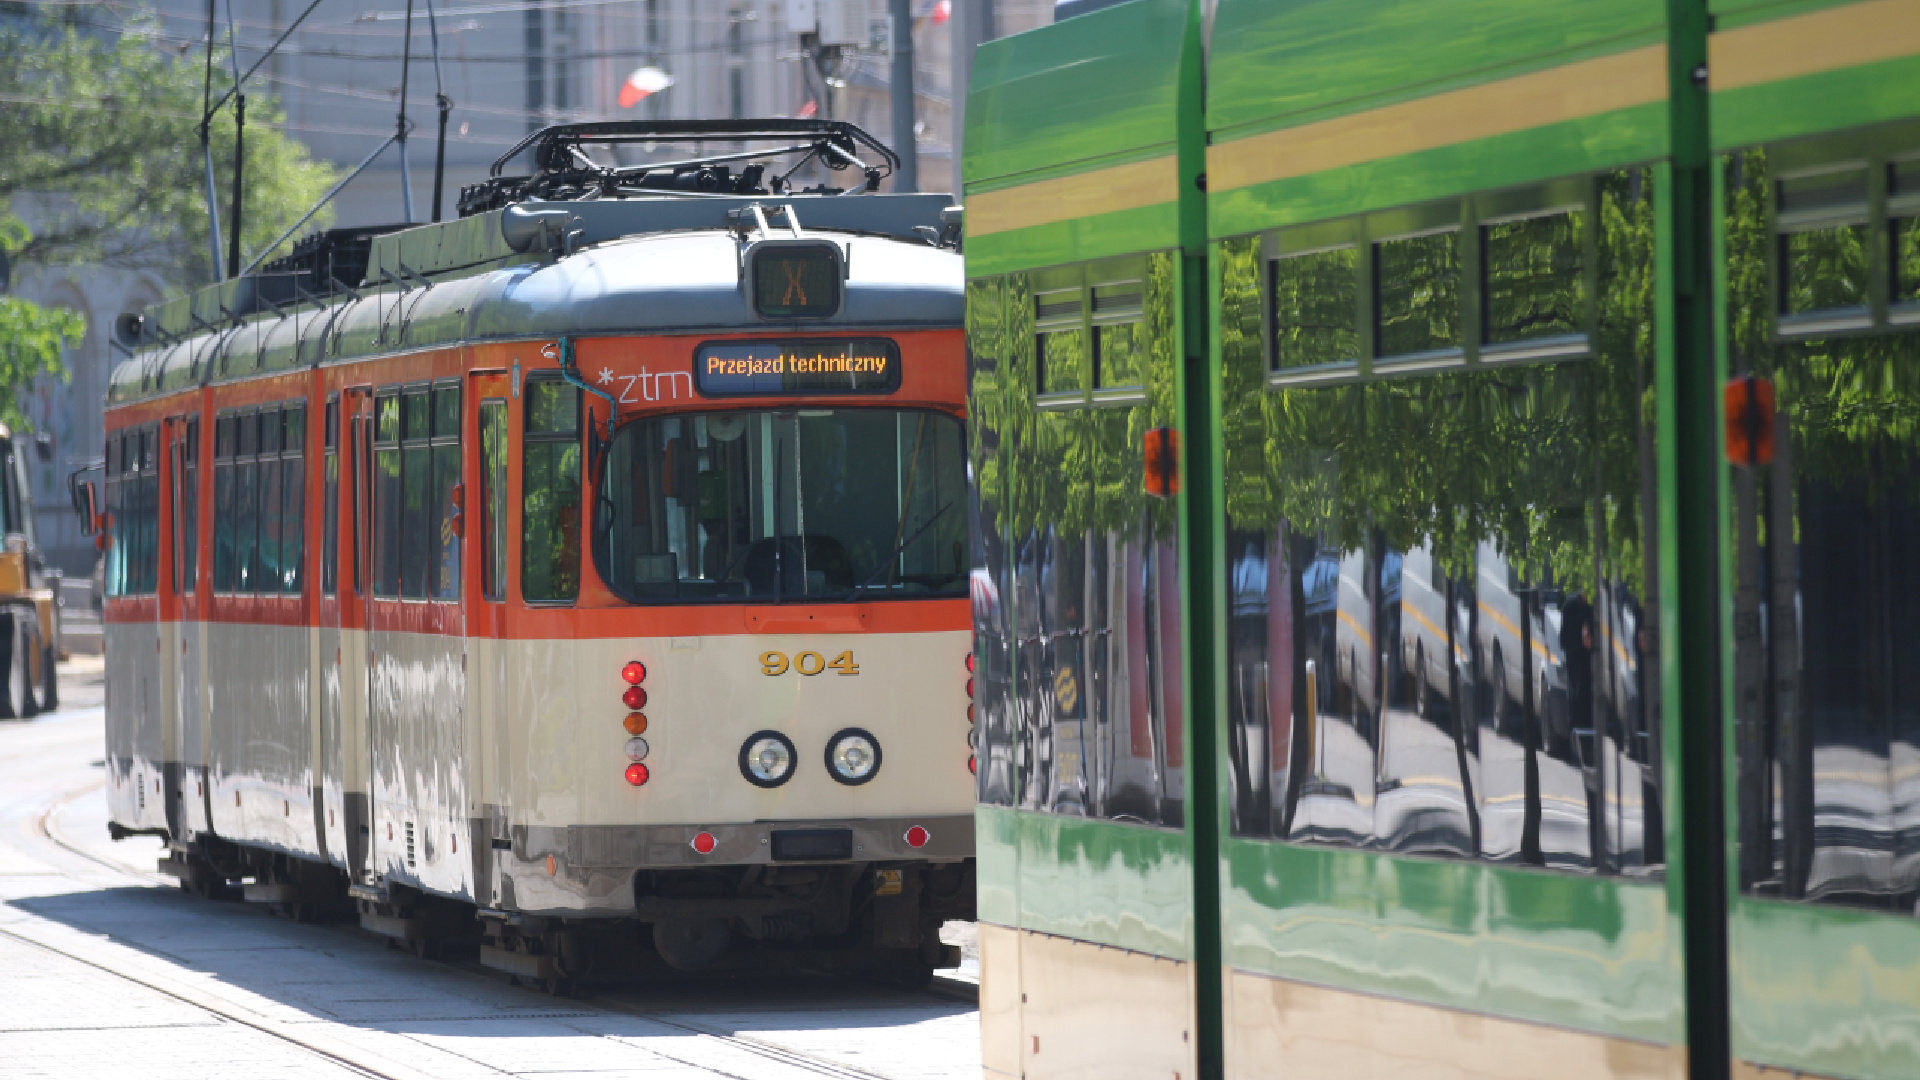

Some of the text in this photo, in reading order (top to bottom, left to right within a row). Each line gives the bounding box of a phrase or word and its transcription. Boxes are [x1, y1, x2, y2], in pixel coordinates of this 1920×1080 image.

[782, 259, 807, 305] X
[707, 352, 886, 377] Przejazd techniczny
[759, 650, 860, 676] 904
